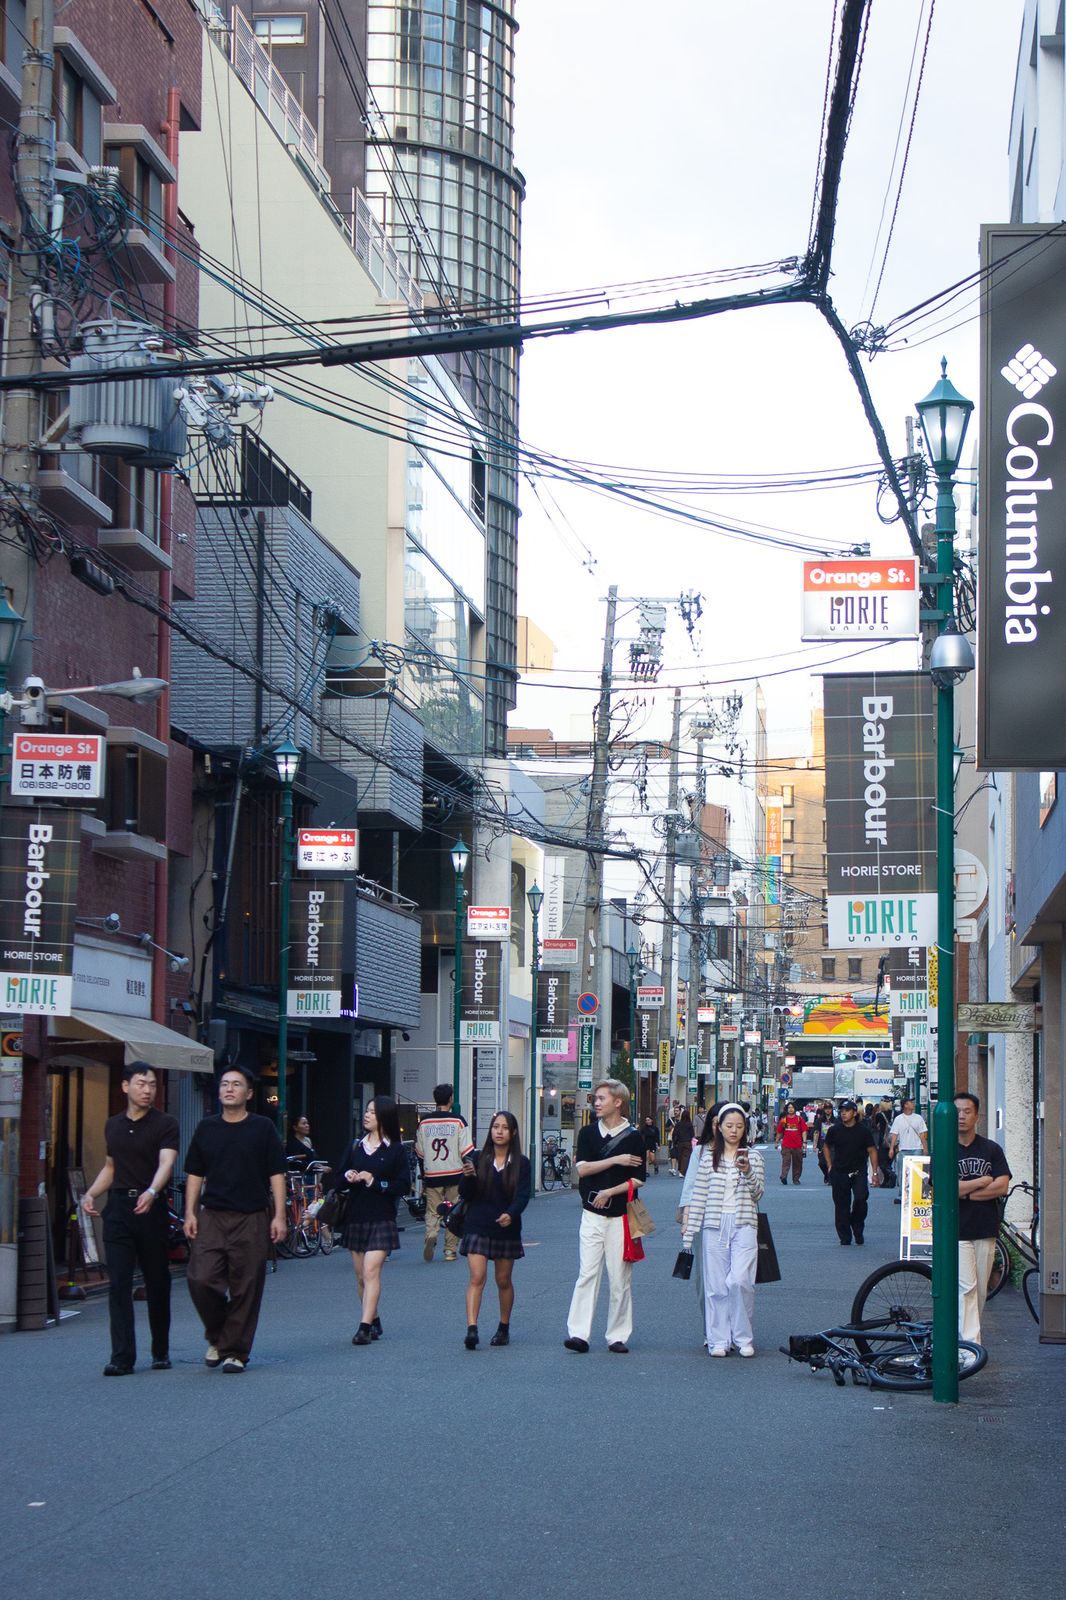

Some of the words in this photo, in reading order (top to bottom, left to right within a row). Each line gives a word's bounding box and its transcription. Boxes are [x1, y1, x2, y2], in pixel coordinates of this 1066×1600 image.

[1004, 401, 1054, 644] Columbia
[810, 568, 881, 588] Orange
[887, 568, 910, 583] St.
[20, 740, 73, 757] Orange
[77, 742, 95, 754] St.
[21, 763, 92, 781] 日本防備
[862, 696, 895, 845] Barbour
[19, 781, 91, 790] (06)532-0800
[302, 833, 339, 844] Orange
[340, 833, 353, 842] St.
[24, 824, 53, 938] Barbour
[841, 866, 879, 877] HORIE
[882, 865, 922, 876] STORE
[470, 909, 497, 918] Orange
[498, 909, 508, 917] St.
[306, 890, 325, 967] Barbour
[4, 951, 32, 960] HORIE
[34, 952, 63, 962] STORE
[474, 948, 487, 1004] Barbour
[547, 977, 559, 1024] Barbour
[900, 992, 928, 1010] HORI
[641, 1014, 650, 1049] Barbour
[919, 1057, 927, 1088] OBEY
[431, 1138, 449, 1161] 93
